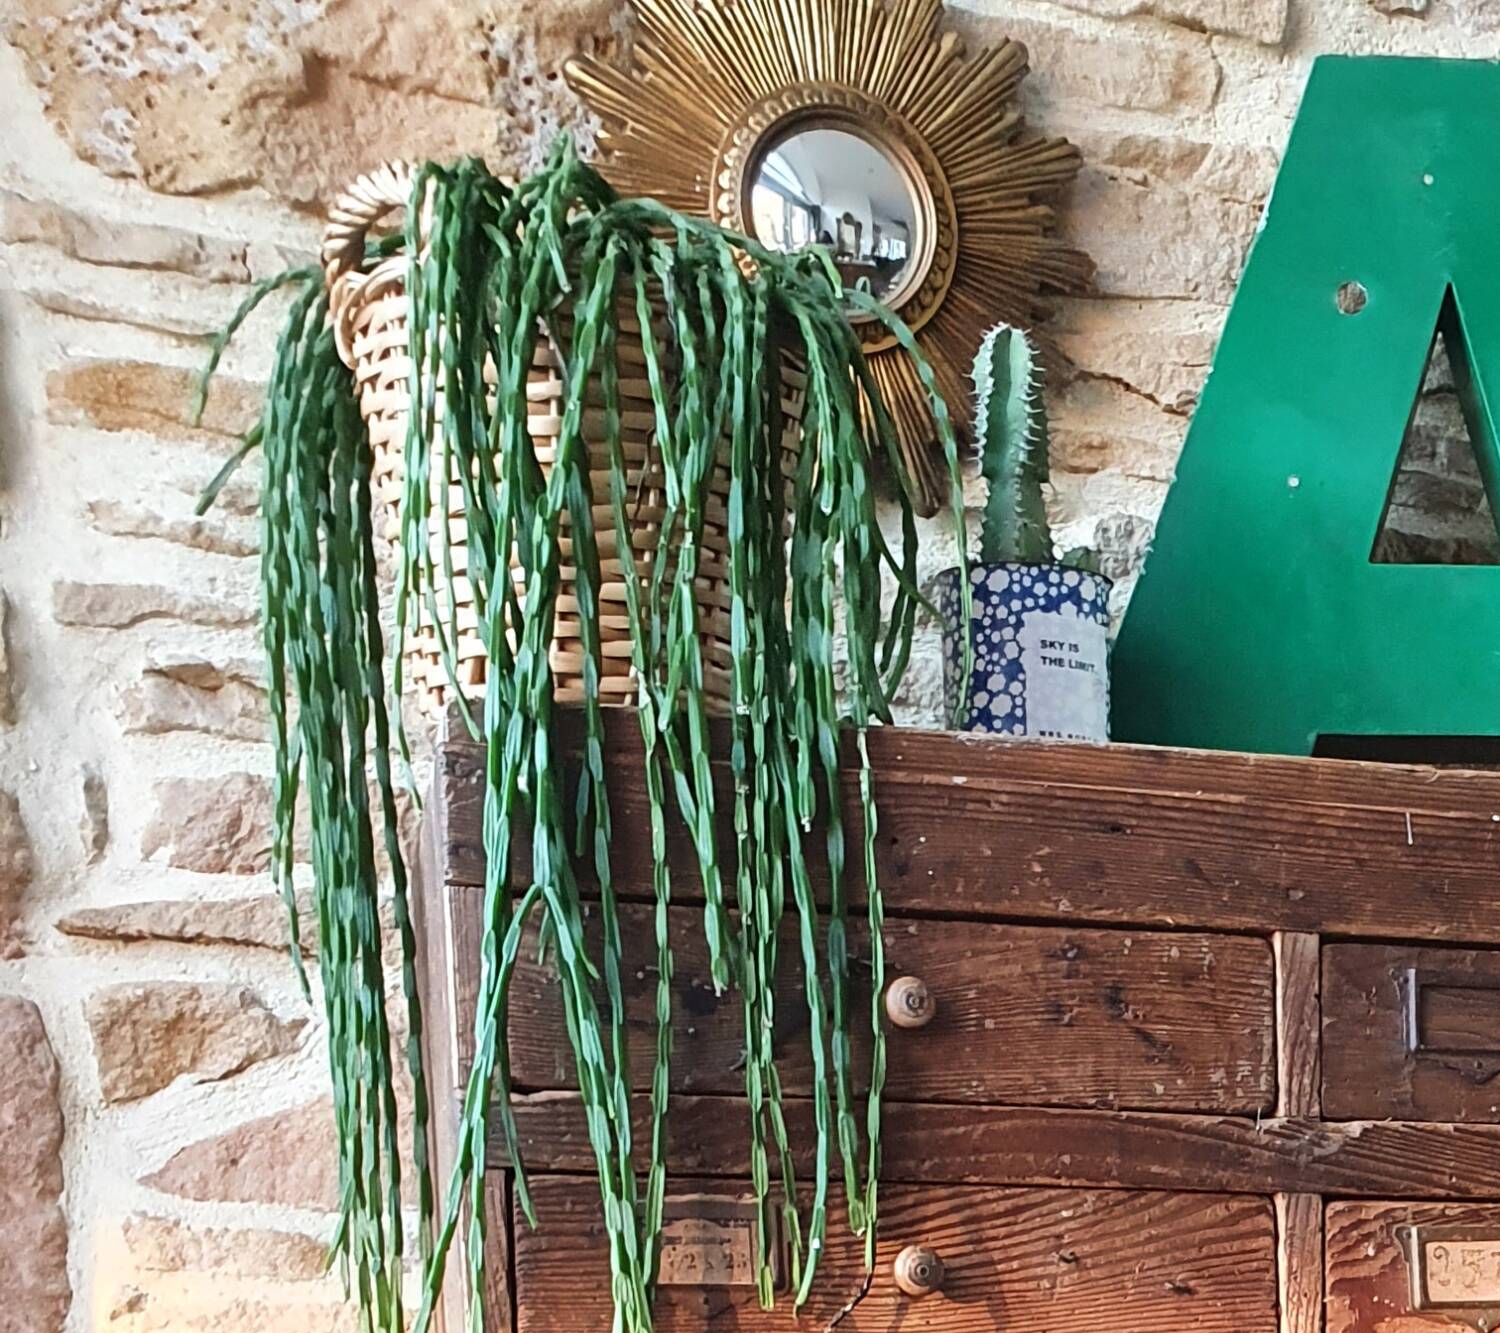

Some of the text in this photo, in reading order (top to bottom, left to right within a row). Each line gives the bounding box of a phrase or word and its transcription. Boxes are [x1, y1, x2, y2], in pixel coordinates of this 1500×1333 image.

[1040, 639, 1080, 654] SKY IS
[1040, 655, 1065, 668] THE
